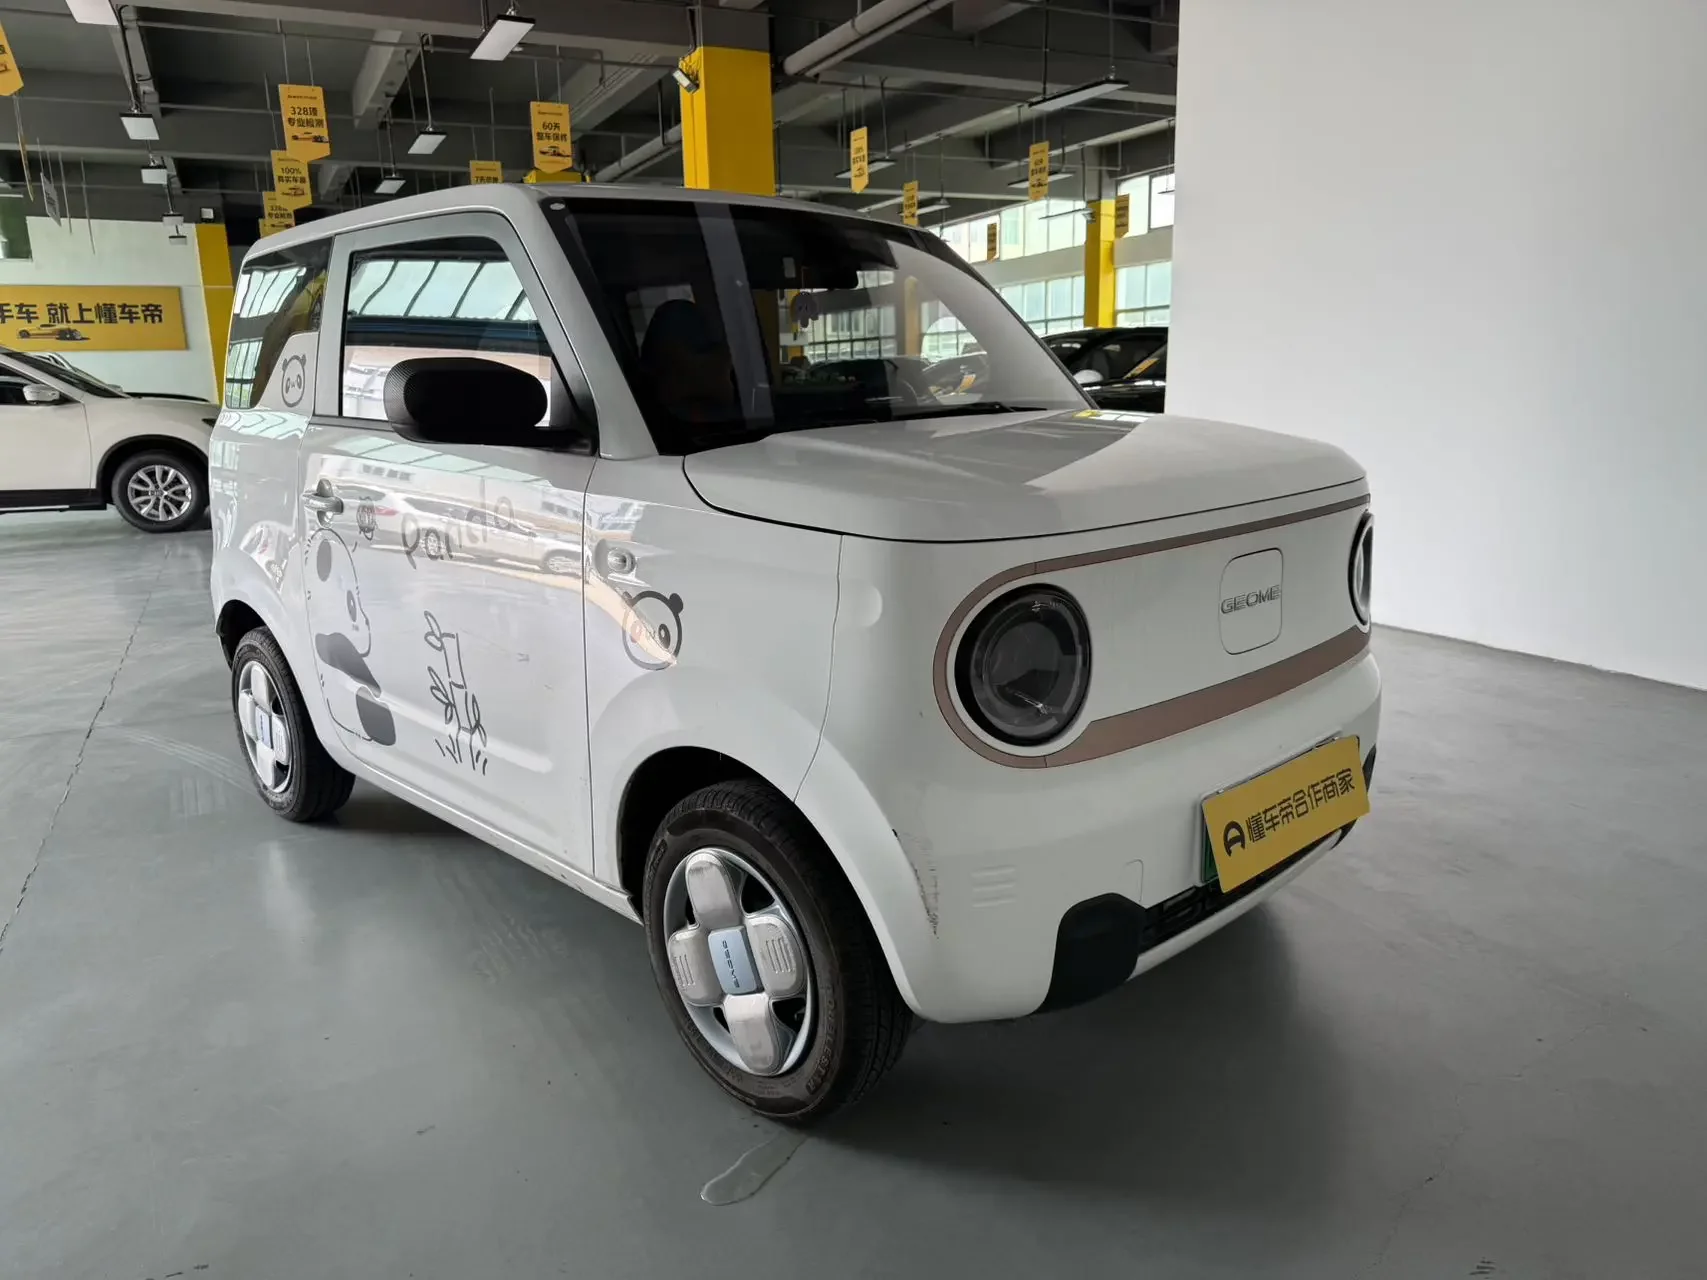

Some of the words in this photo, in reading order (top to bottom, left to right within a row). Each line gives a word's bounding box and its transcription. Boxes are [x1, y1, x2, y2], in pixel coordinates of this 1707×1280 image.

[46, 303, 163, 324] 就上懂车帝
[1221, 584, 1280, 614] GEOME
[1245, 768, 1356, 843] 懂车帝合作商家
